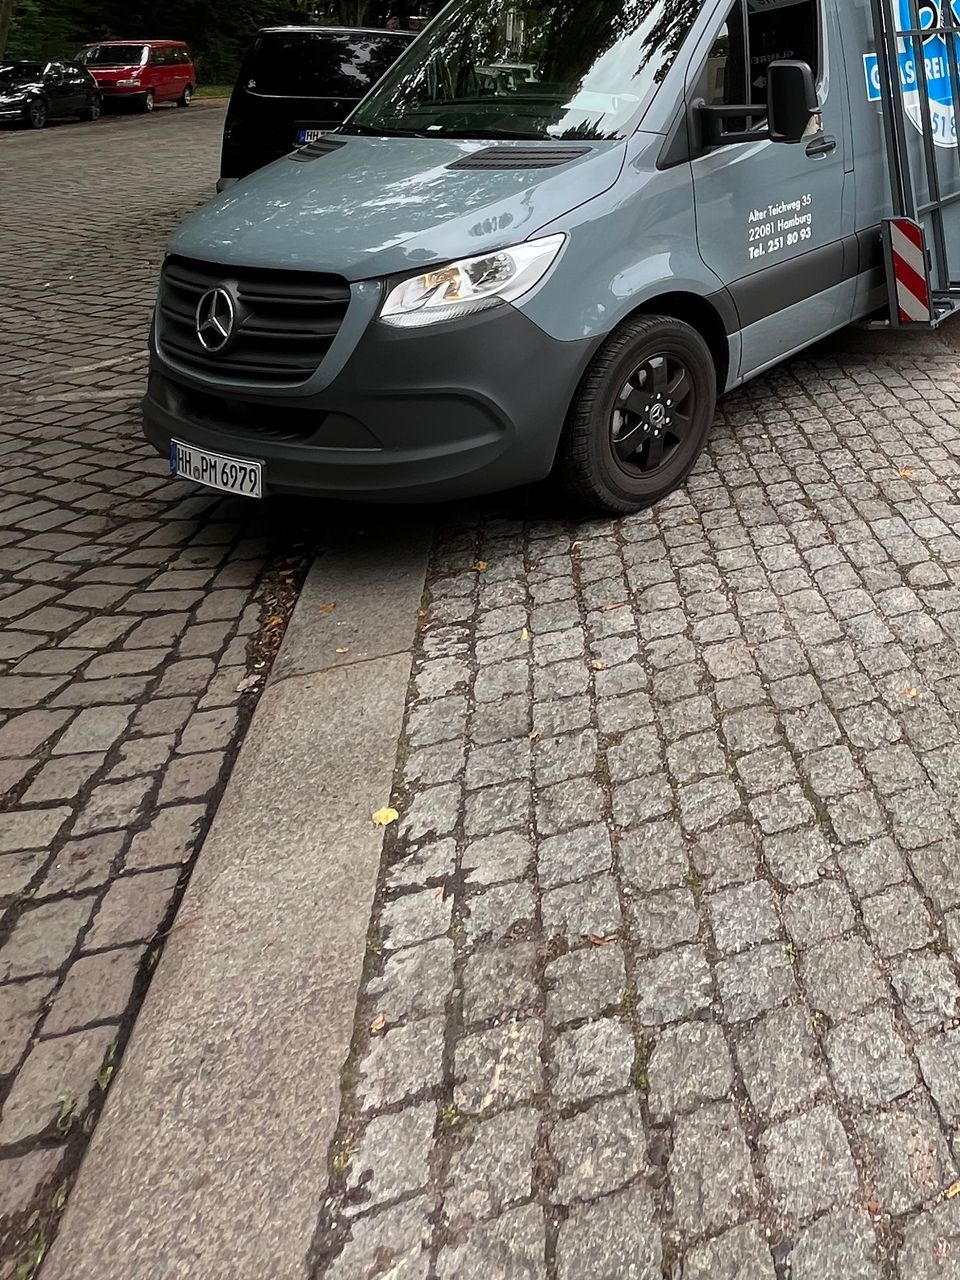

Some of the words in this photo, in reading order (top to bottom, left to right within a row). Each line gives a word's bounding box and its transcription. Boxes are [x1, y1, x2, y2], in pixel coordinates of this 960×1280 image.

[748, 209, 767, 224] Alter
[768, 200, 801, 217] Teichweg
[801, 193, 811, 207] 35
[748, 222, 775, 241] 22081
[777, 213, 811, 231] Hamburg
[748, 243, 765, 259] Tel.
[768, 236, 783, 253] 251
[786, 231, 798, 245] 80
[800, 226, 811, 240] 93
[177, 447, 192, 476] HH
[201, 456, 217, 485] PM
[221, 462, 257, 493] 6979
